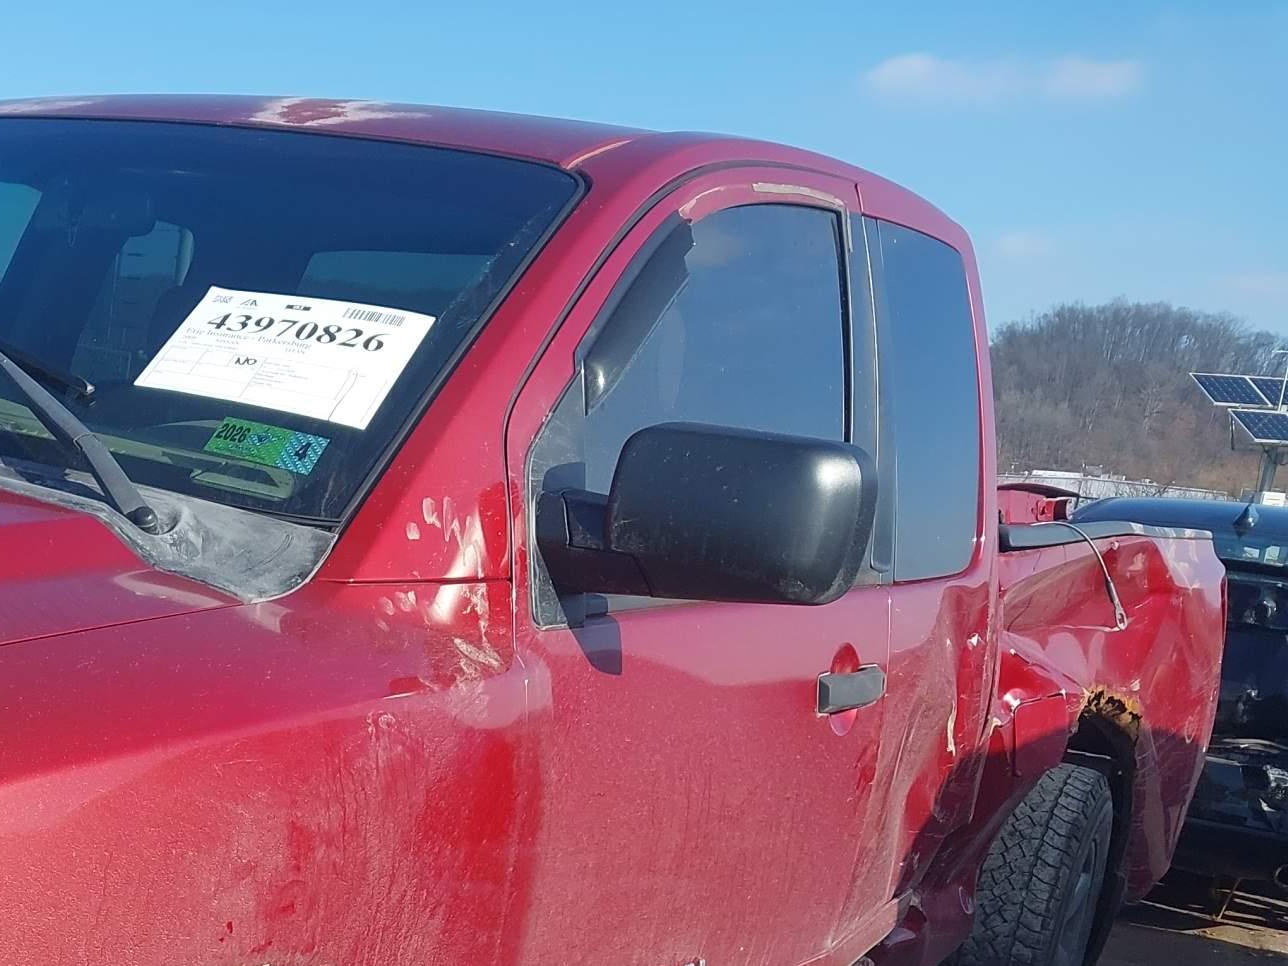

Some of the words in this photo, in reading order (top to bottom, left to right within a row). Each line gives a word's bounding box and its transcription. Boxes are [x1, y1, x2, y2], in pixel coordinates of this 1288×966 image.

[207, 312, 392, 352] 43970826
[215, 422, 251, 443] 2026
[293, 442, 313, 461] 4
